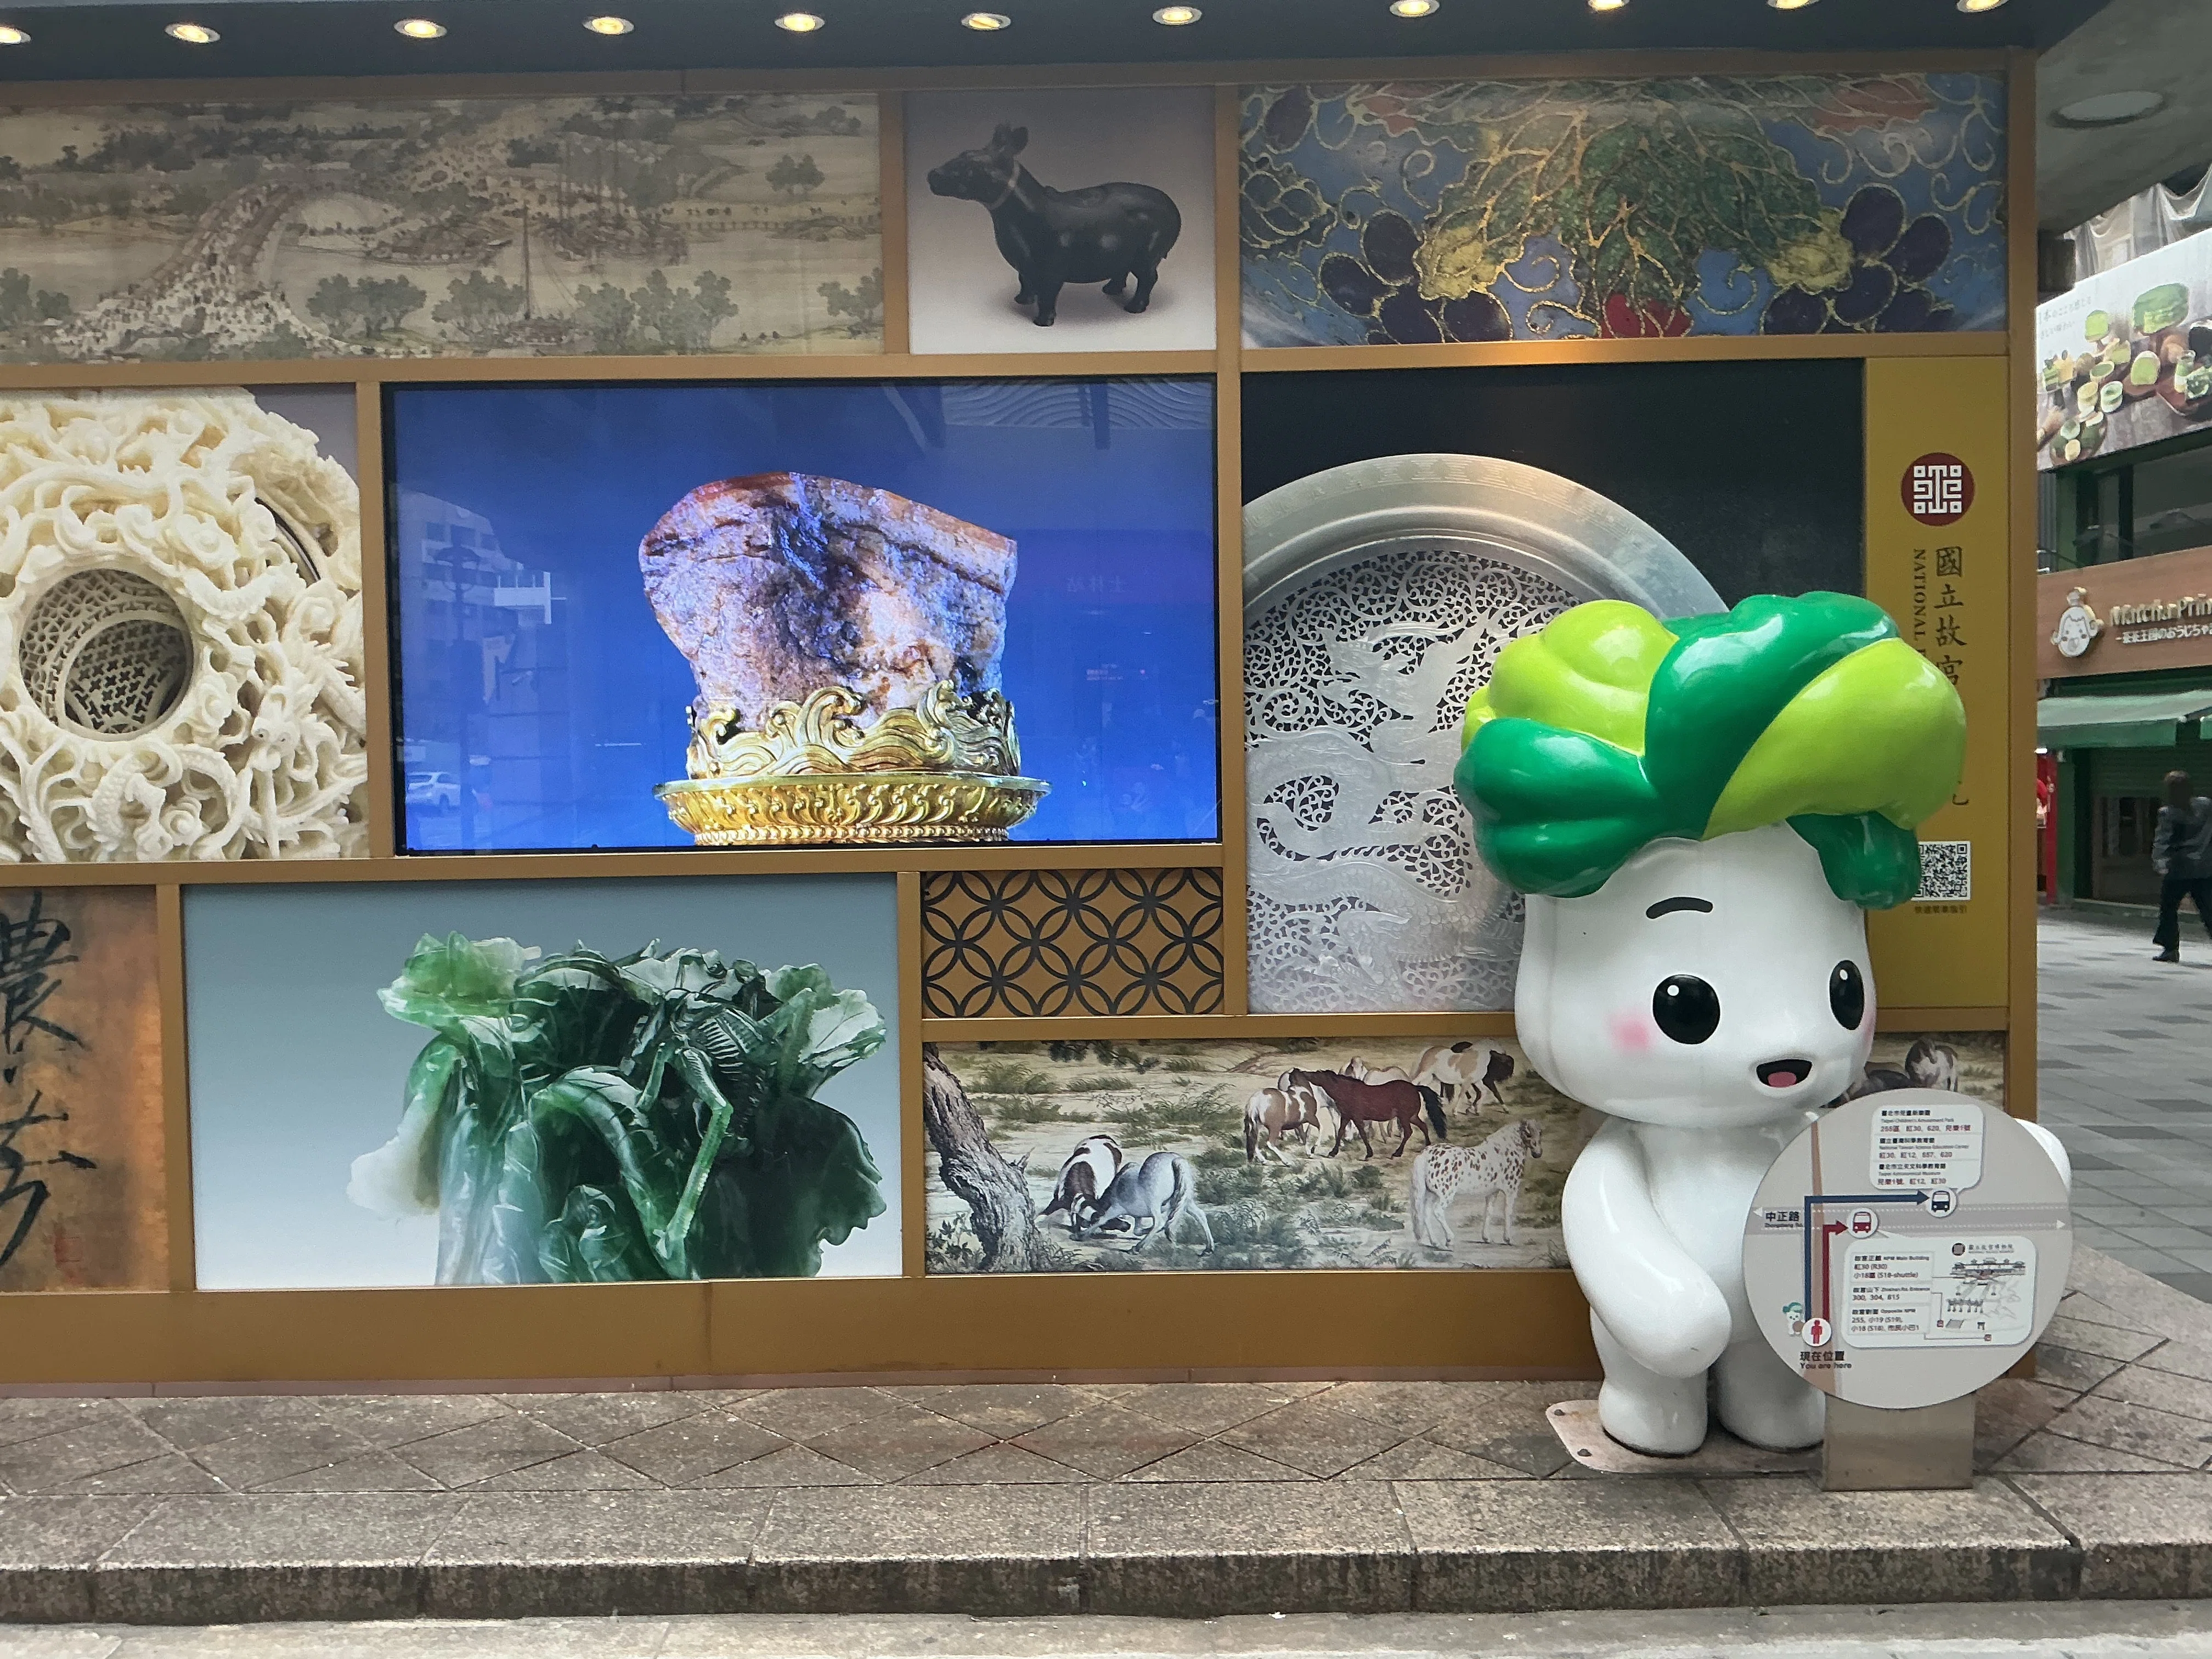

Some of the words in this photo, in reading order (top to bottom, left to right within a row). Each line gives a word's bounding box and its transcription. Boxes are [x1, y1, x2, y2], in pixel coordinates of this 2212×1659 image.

[1914, 549, 1926, 641] NATIONAL
[1765, 1211, 1799, 1222] 中正路
[1799, 1350, 1846, 1361] 現在位置
